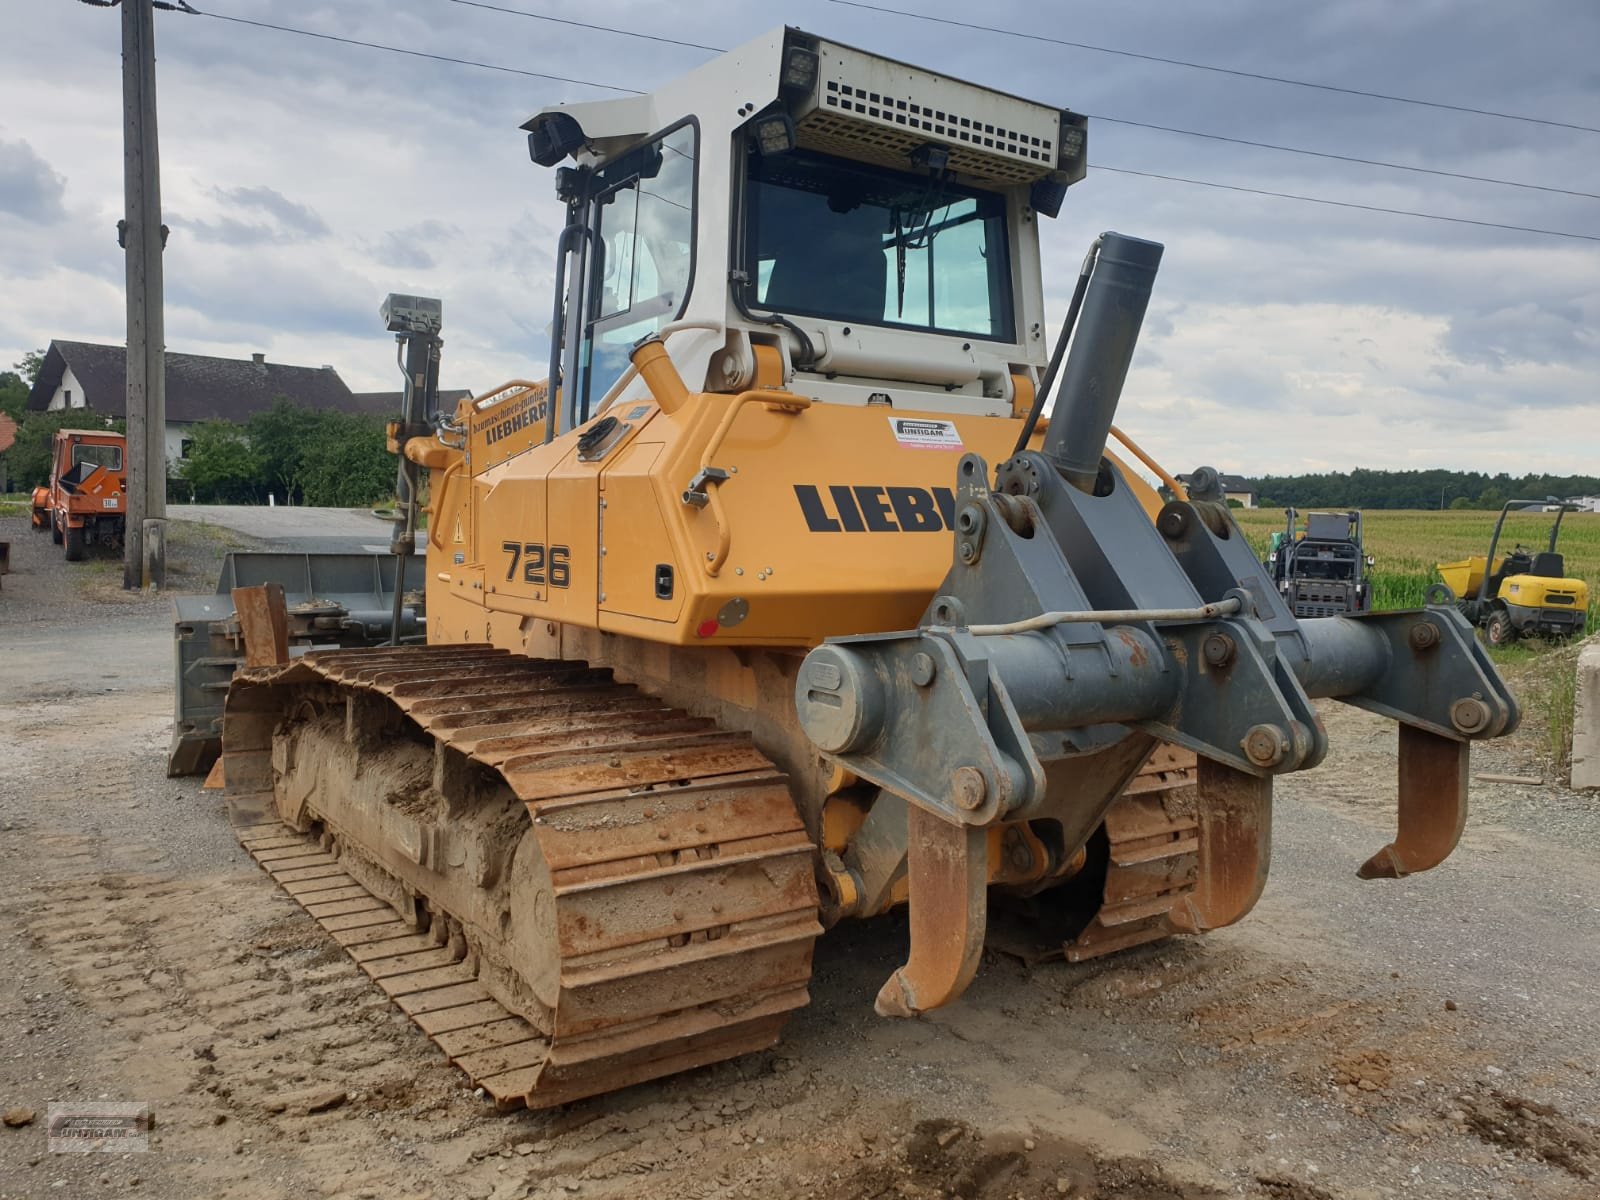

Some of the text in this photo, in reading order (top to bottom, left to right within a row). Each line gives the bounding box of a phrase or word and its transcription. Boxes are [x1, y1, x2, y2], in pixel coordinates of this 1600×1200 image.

[473, 386, 548, 434] baumaschinen-puntiga
[486, 400, 548, 446] LIEBHERR
[793, 484, 956, 532] LIEB
[502, 541, 571, 589] 726
